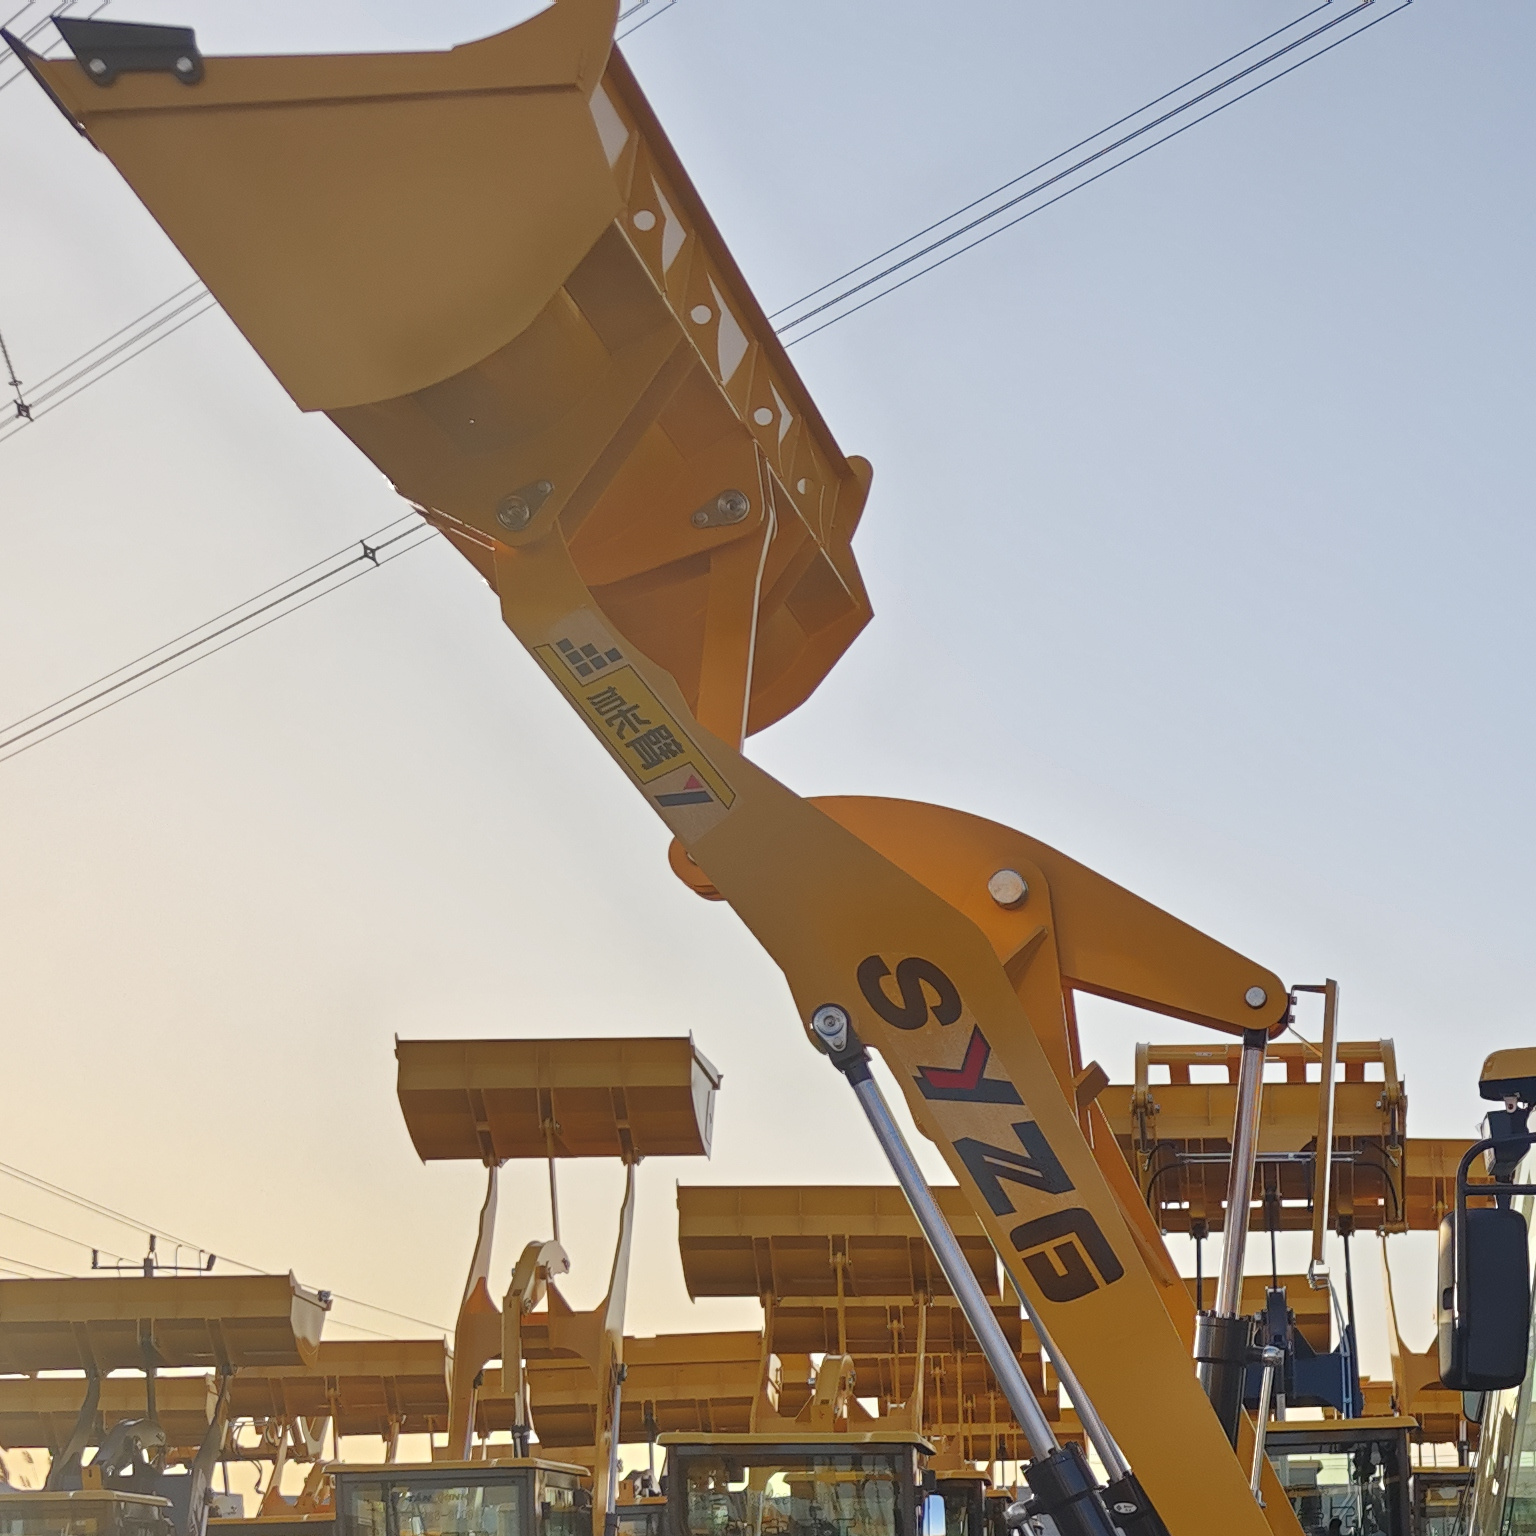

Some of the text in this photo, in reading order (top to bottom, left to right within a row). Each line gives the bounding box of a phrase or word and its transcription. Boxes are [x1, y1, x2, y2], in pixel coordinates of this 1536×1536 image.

[586, 685, 686, 770] 加长臂
[856, 954, 1126, 1304] SYZG
